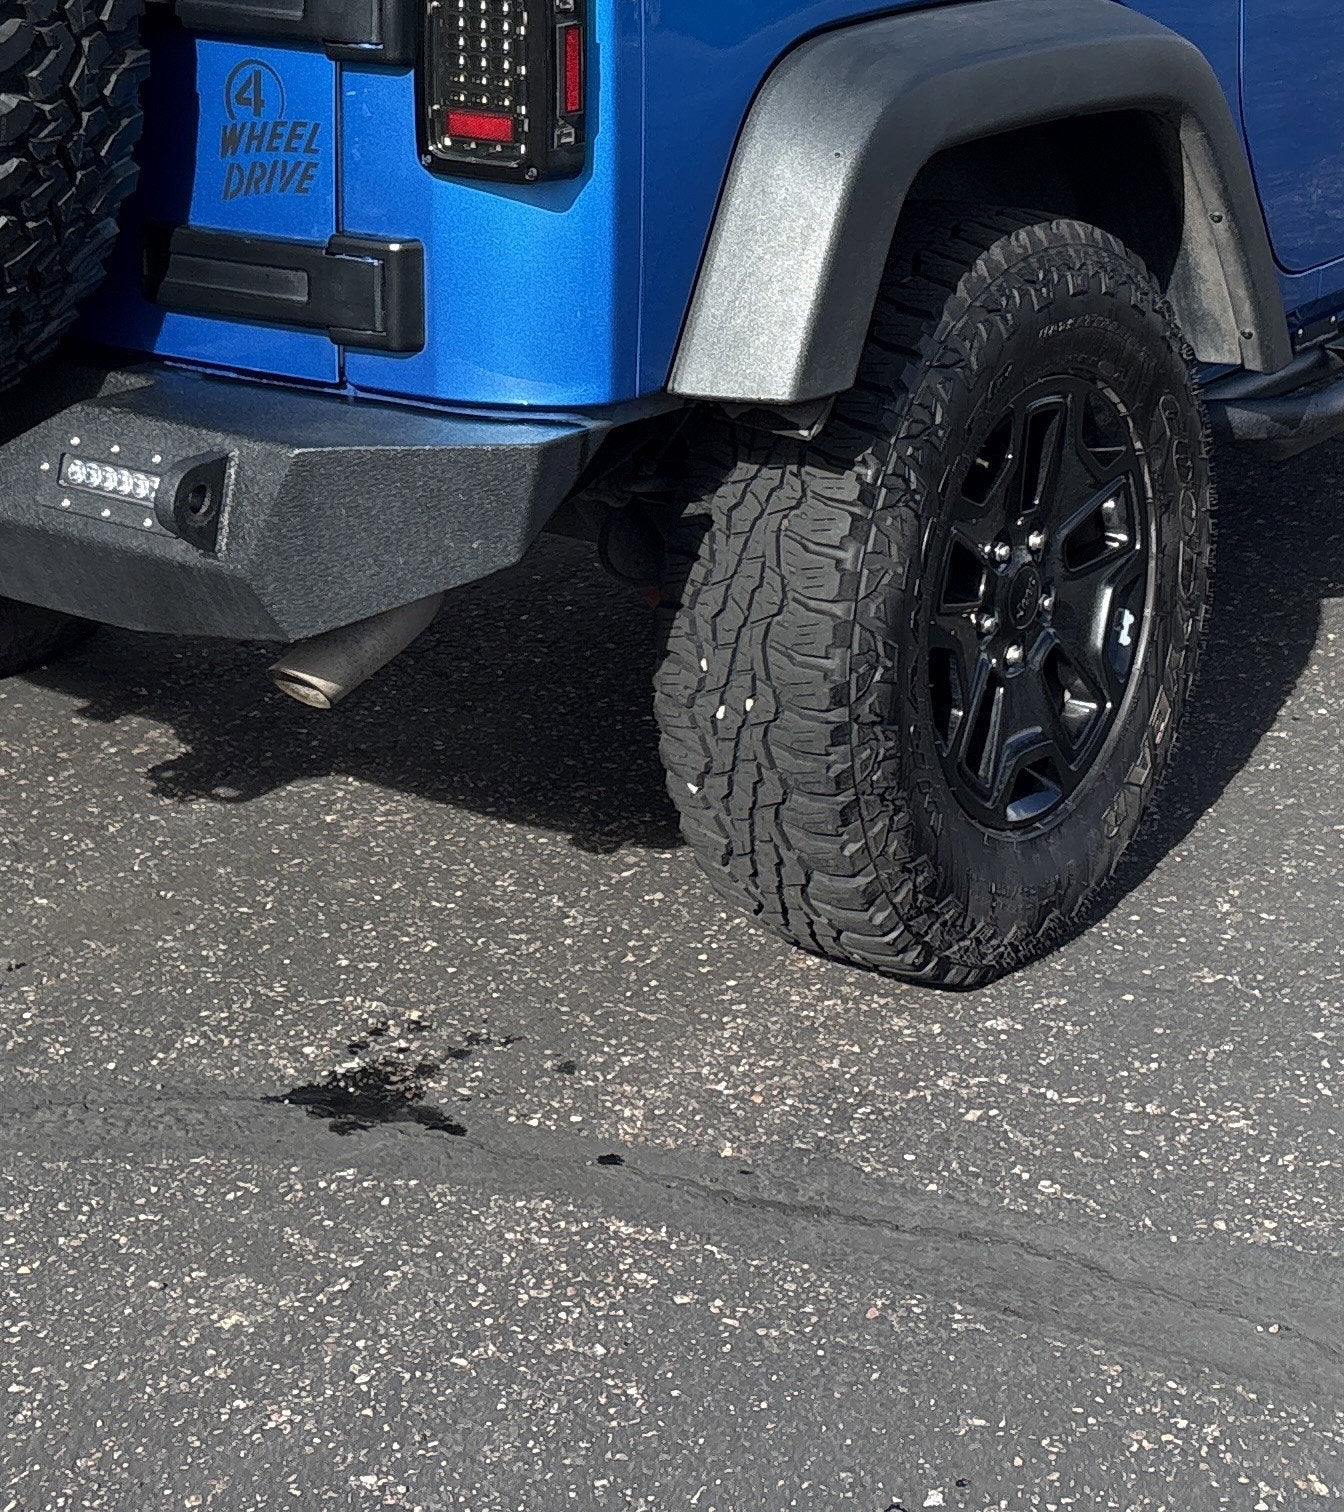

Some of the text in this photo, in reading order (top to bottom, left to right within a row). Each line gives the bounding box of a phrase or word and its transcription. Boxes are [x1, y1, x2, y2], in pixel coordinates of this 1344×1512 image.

[235, 70, 265, 117] 4
[220, 120, 321, 158] WHEEL
[222, 159, 319, 202] DRIVE
